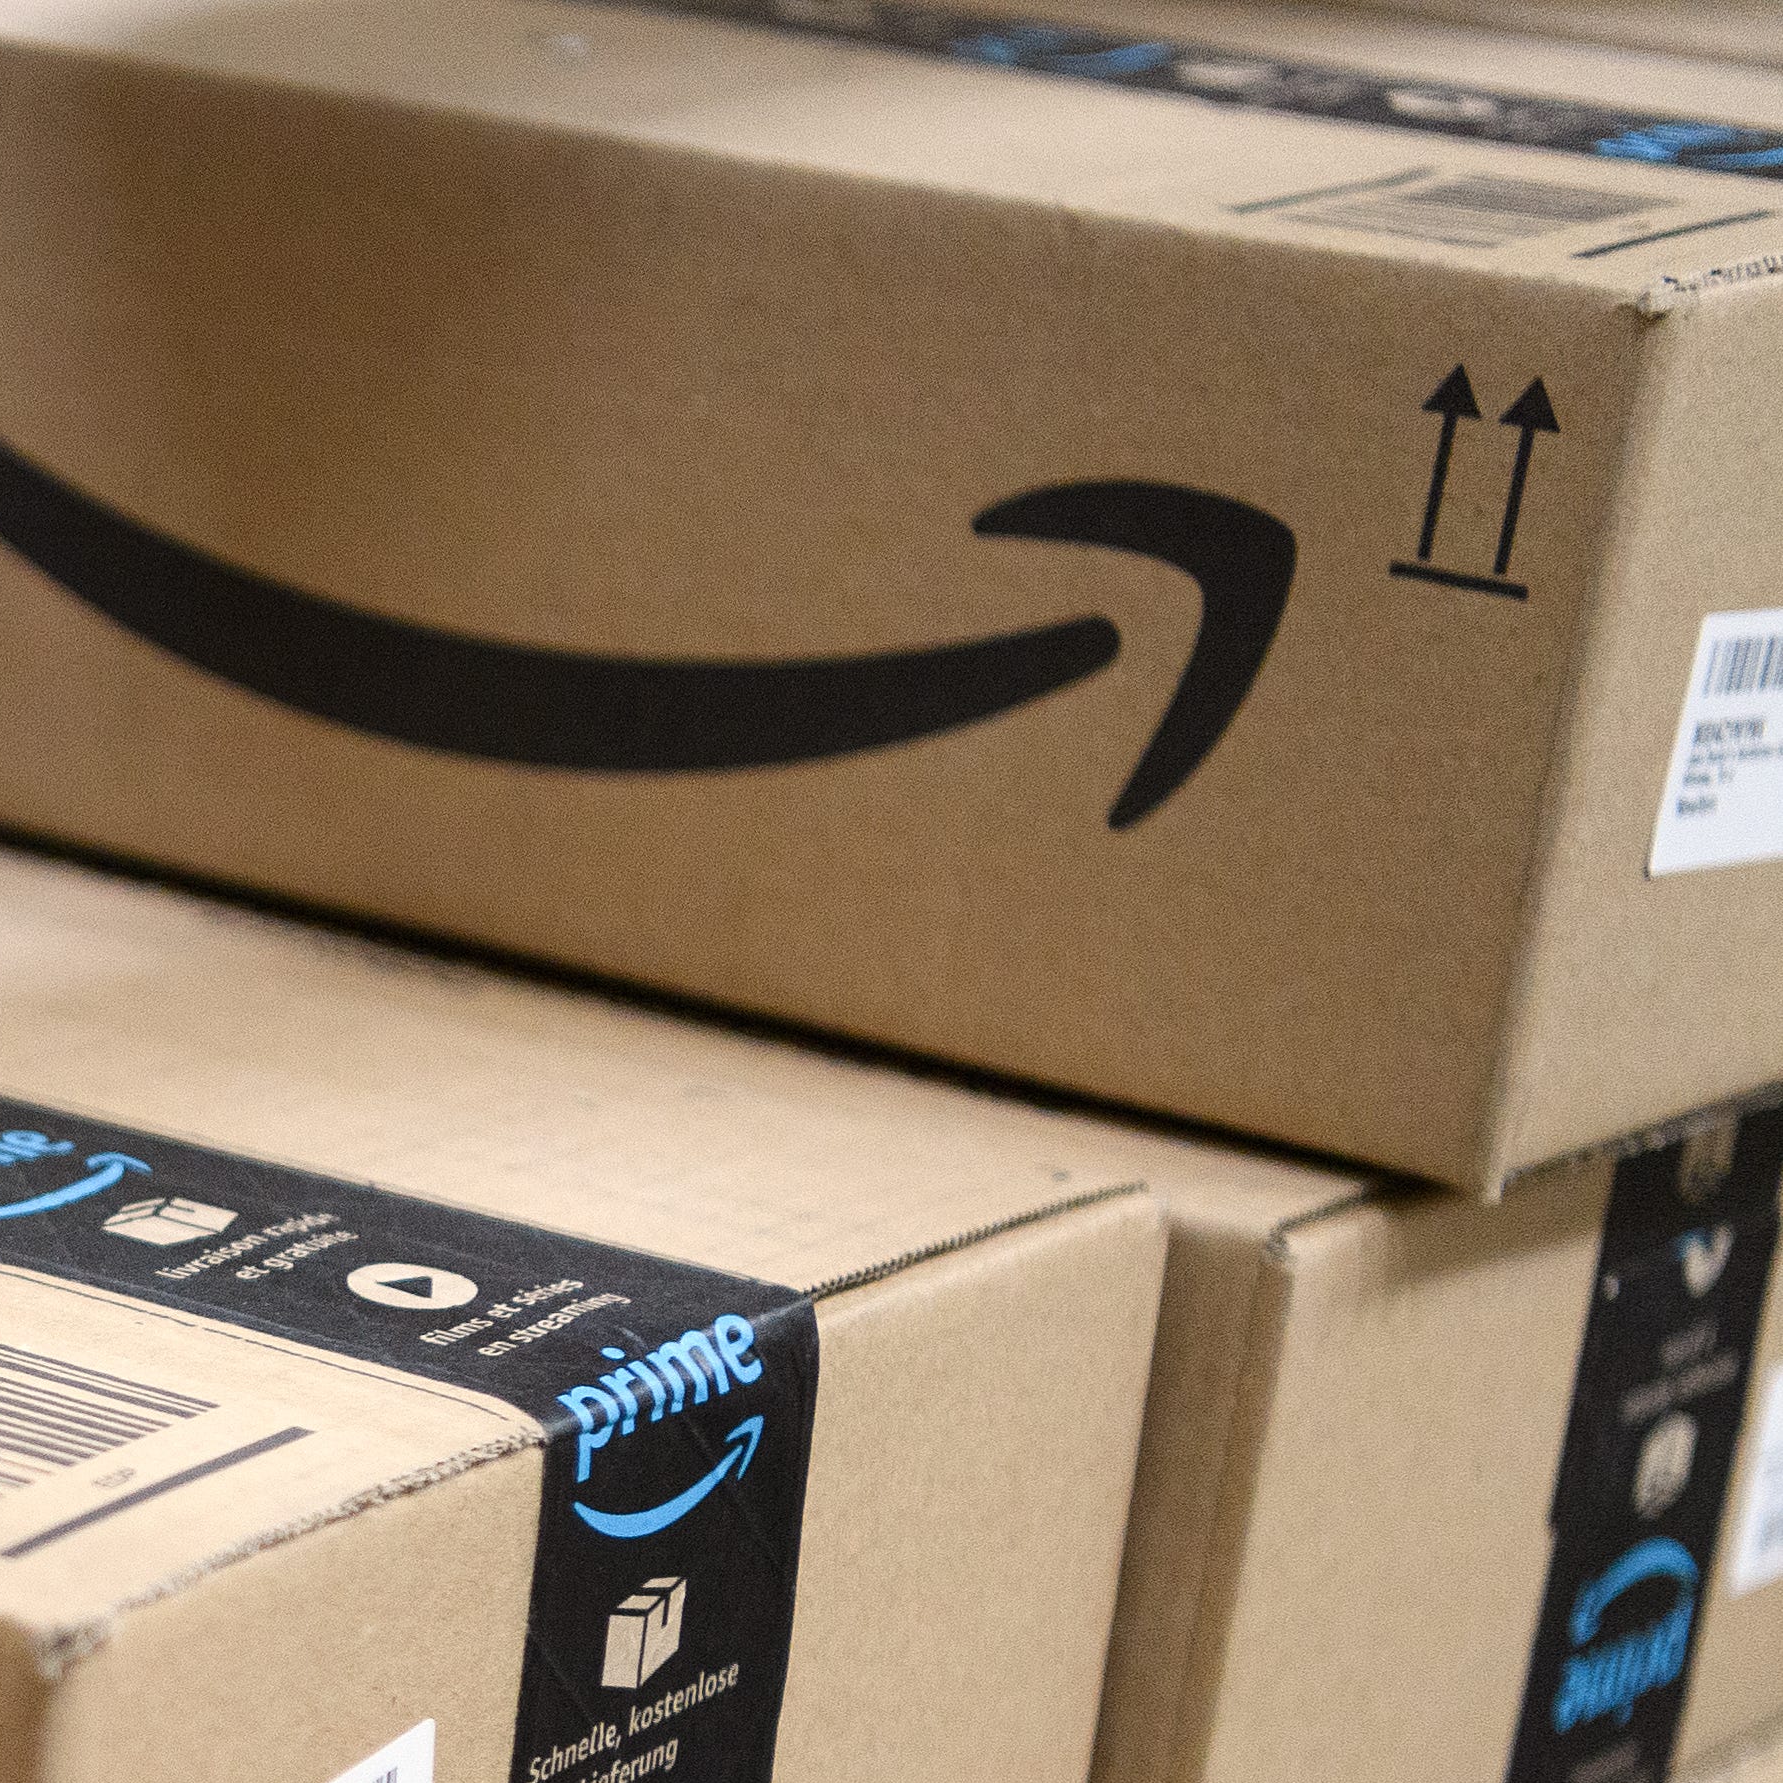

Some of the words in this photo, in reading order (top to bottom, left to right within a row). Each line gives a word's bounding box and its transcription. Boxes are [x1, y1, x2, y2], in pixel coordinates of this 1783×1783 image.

[155, 1227, 265, 1279] livraison
[267, 1211, 341, 1244] rapide
[236, 1262, 270, 1280] et
[270, 1229, 360, 1272] gratuite
[420, 1313, 492, 1347] films
[487, 1298, 520, 1319] et
[519, 1276, 585, 1308] séries
[478, 1341, 513, 1358] en
[510, 1291, 632, 1348] streaming
[555, 1313, 764, 1484] prime
[629, 1663, 739, 1737] kostenlose
